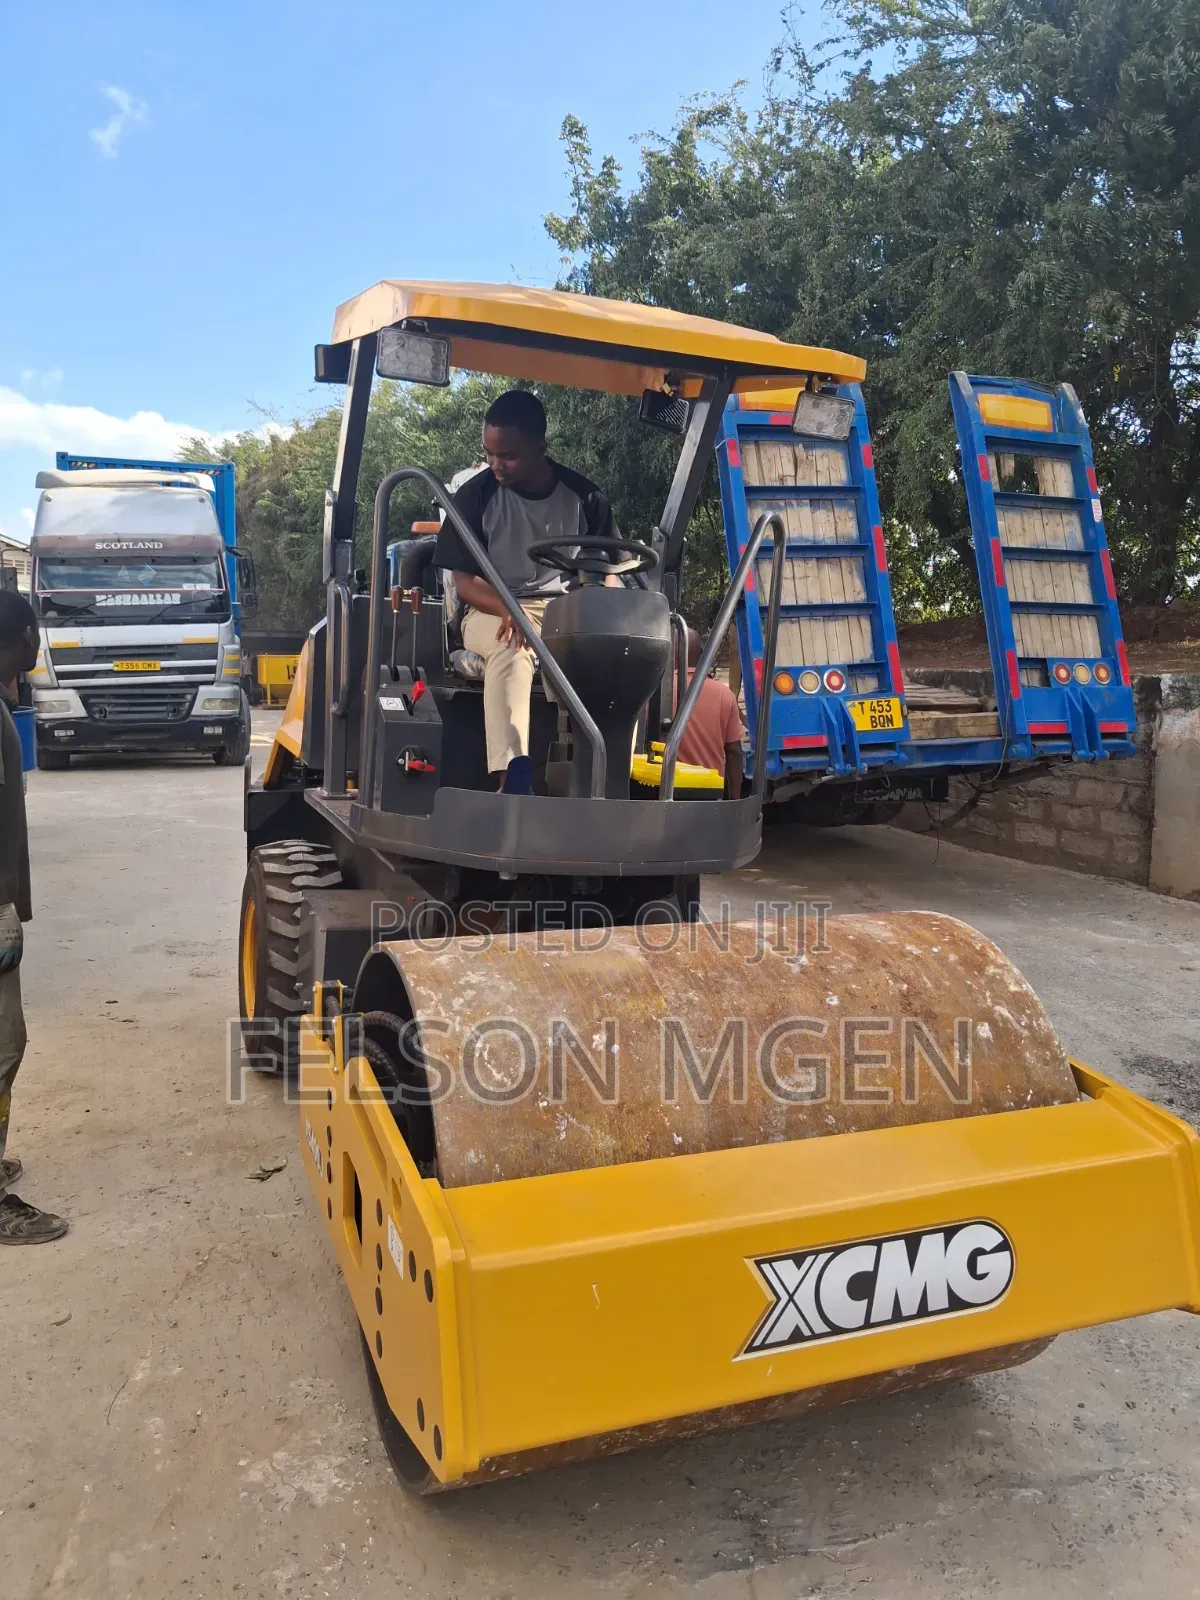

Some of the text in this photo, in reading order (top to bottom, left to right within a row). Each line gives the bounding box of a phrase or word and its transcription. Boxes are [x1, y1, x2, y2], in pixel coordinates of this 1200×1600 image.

[94, 541, 164, 550] SCOTLAND
[119, 662, 157, 670] T356 CMX
[858, 699, 892, 715] T 453
[869, 714, 895, 729] BQN
[752, 1223, 1012, 1347] XCMG
